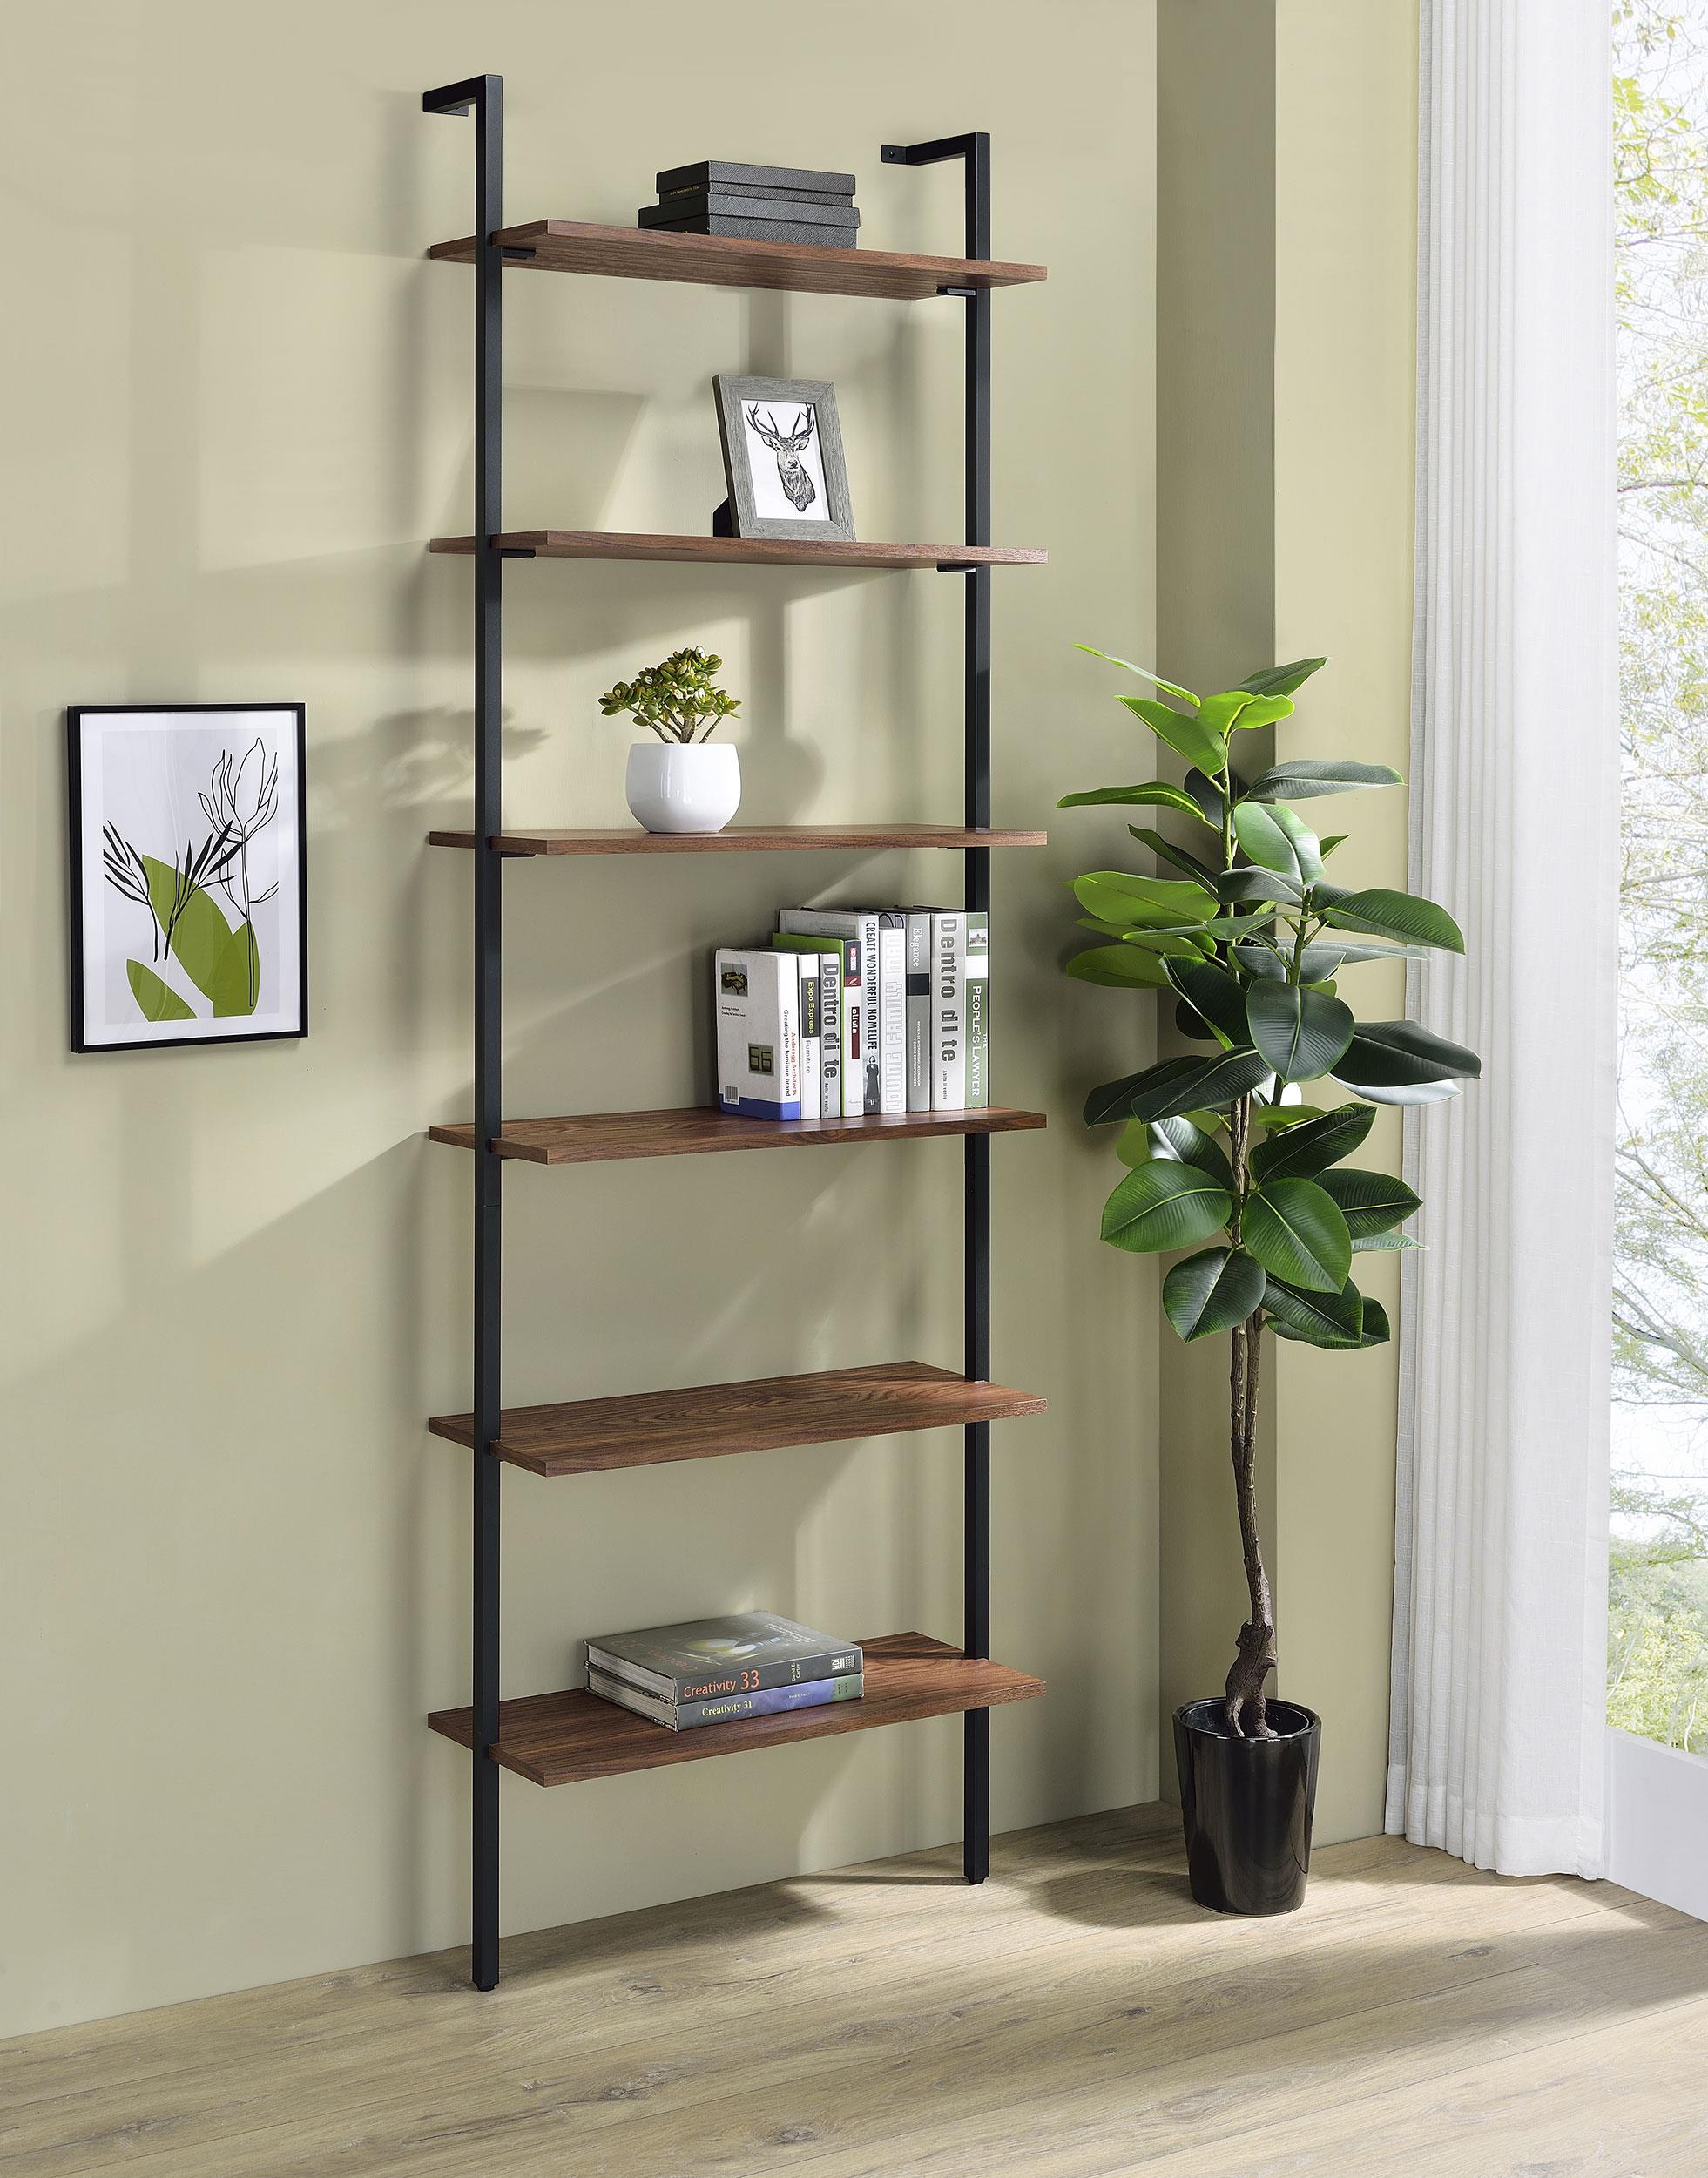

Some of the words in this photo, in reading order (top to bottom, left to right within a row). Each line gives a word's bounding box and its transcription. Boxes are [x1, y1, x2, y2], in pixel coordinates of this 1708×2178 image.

[866, 922, 876, 951] CREATE
[909, 928, 923, 967] Elegance
[941, 919, 957, 998] Dentro
[823, 964, 839, 1026] Dentro
[866, 954, 877, 1006] WONDERFUL
[867, 1009, 878, 1050] HOMELIFE
[941, 1010, 958, 1032] di
[972, 985, 982, 1043] PEOPLE'S
[823, 1032, 840, 1050] di
[941, 1039, 958, 1061] te
[823, 1059, 840, 1078] te
[972, 1046, 982, 1096] LAWYER
[684, 1680, 737, 1698] Creativity
[740, 1669, 759, 1690] 33
[702, 1701, 742, 1716] Creativity
[743, 1700, 753, 1709] 31
